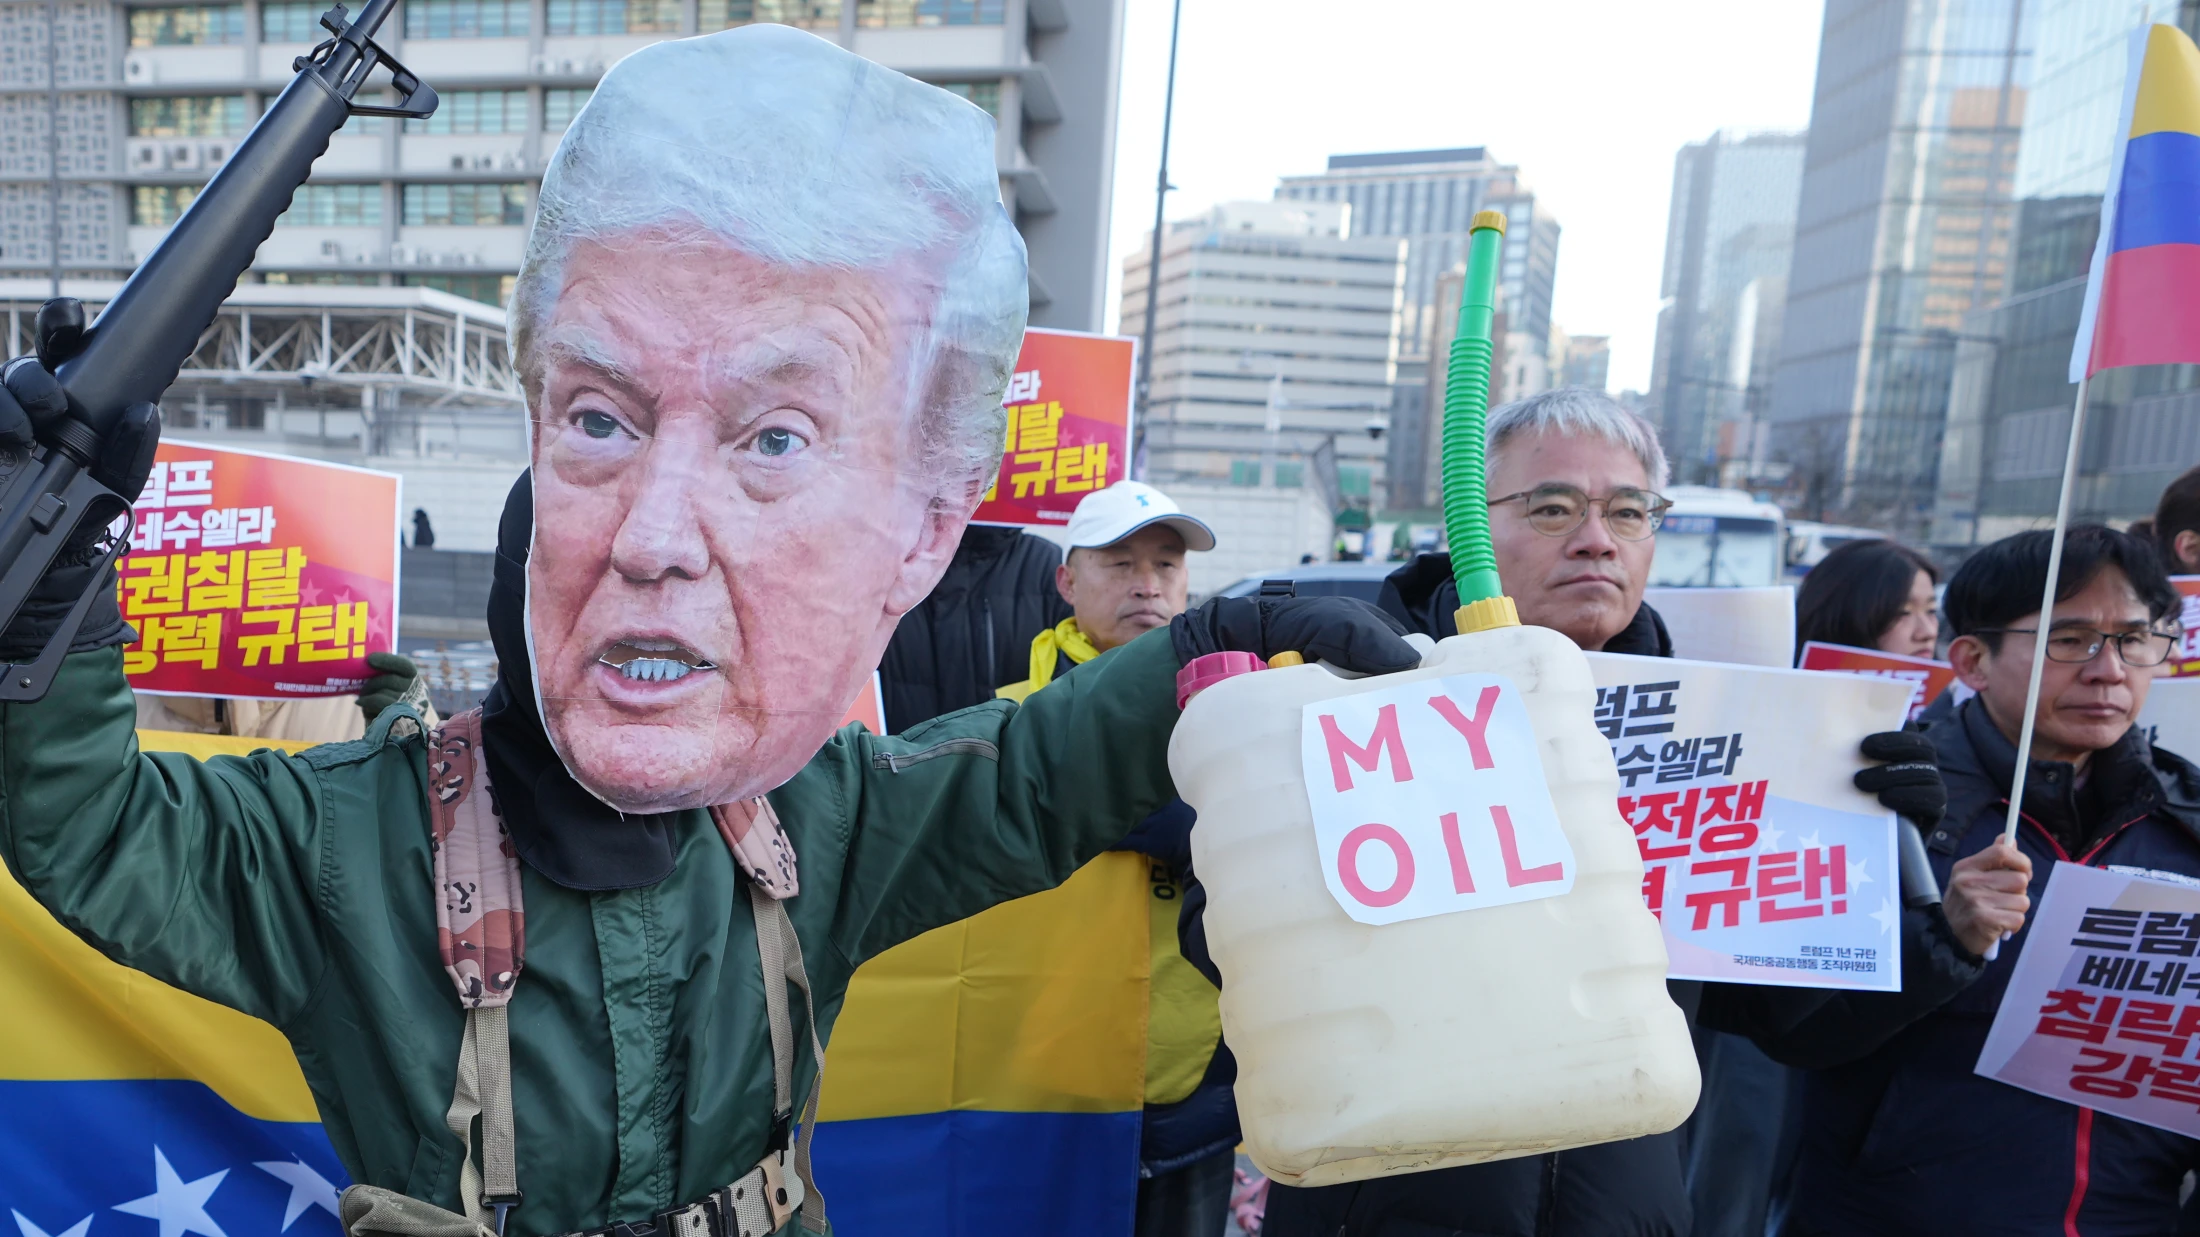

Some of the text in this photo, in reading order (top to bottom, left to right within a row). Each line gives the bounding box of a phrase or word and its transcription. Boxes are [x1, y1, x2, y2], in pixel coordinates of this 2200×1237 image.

[132, 460, 213, 509] 럼프
[1010, 442, 1108, 499] 규탄!
[103, 505, 276, 553] 네수엘라
[116, 546, 307, 616] 권침탈
[123, 601, 368, 674] 강력 규탄!
[1318, 685, 1501, 793] MY
[1594, 681, 1680, 740] 럼프
[1614, 733, 1743, 788] 수엘라
[1337, 805, 1564, 908] OIL
[1684, 845, 1847, 931] 규탄!
[1800, 945, 1877, 960] 트럼프 1년 규탄
[2070, 907, 2200, 958] 트럼
[1821, 959, 1877, 973] 조직위원회
[2035, 989, 2200, 1062] 침략
